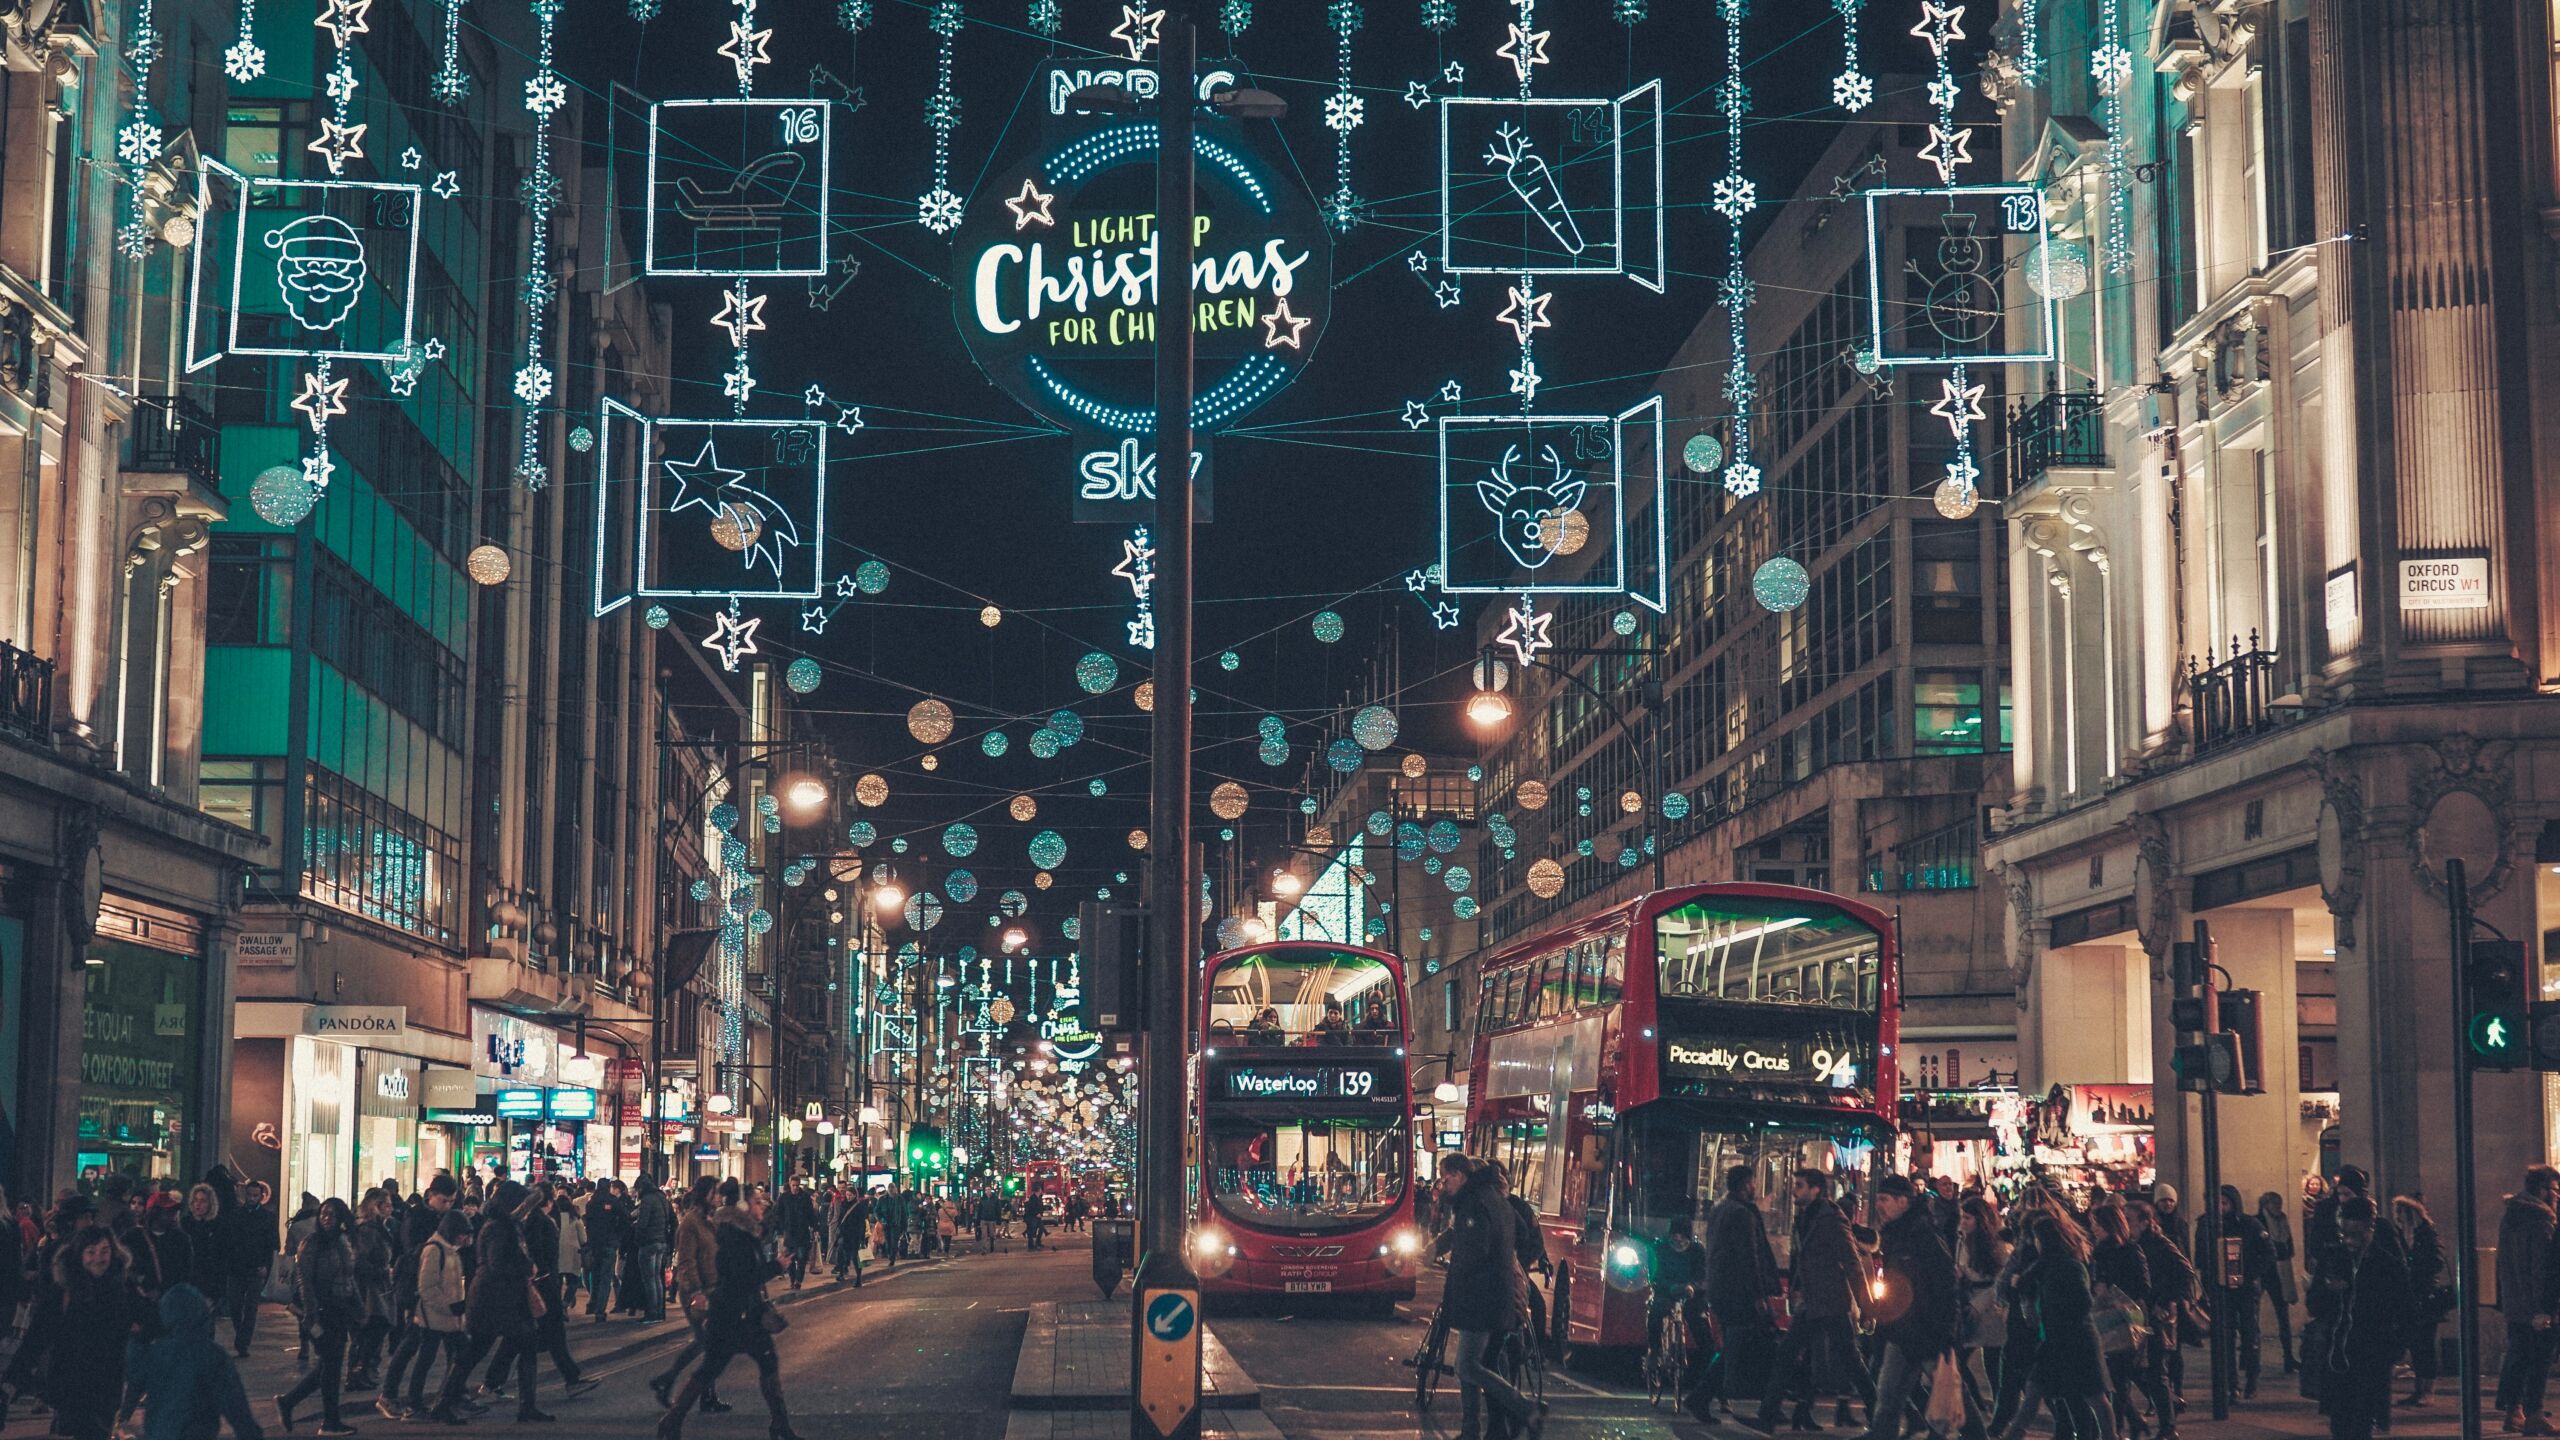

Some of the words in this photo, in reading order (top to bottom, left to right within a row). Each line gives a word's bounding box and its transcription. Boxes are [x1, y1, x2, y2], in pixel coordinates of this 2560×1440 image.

[780, 108, 820, 144] 16
[1567, 106, 1612, 143] 14
[373, 192, 410, 228] 18
[2001, 195, 2038, 231] 13
[1073, 214, 1156, 248] LIGHT
[1050, 317, 1099, 347] FOR
[1109, 296, 1256, 346] CHIREN
[772, 427, 816, 464] 17
[1570, 425, 1612, 460] 15
[2408, 564, 2459, 577] OXFORD
[2408, 579, 2456, 592] CIRCUS
[2461, 578, 2480, 591] W1
[239, 935, 284, 945] SWALLOW
[239, 946, 278, 956] PASSAGE
[280, 946, 293, 955] W1
[97, 1012, 119, 1042] YOU
[120, 1015, 134, 1043] AT
[91, 1054, 137, 1086] OXFORD
[138, 1059, 174, 1089] STREET
[1670, 1045, 1738, 1071] Piccadilly
[1743, 1050, 1790, 1071] Circus
[1812, 1049, 1856, 1083] 94
[1236, 1075, 1318, 1091] Waterloo
[1340, 1071, 1372, 1095] 139
